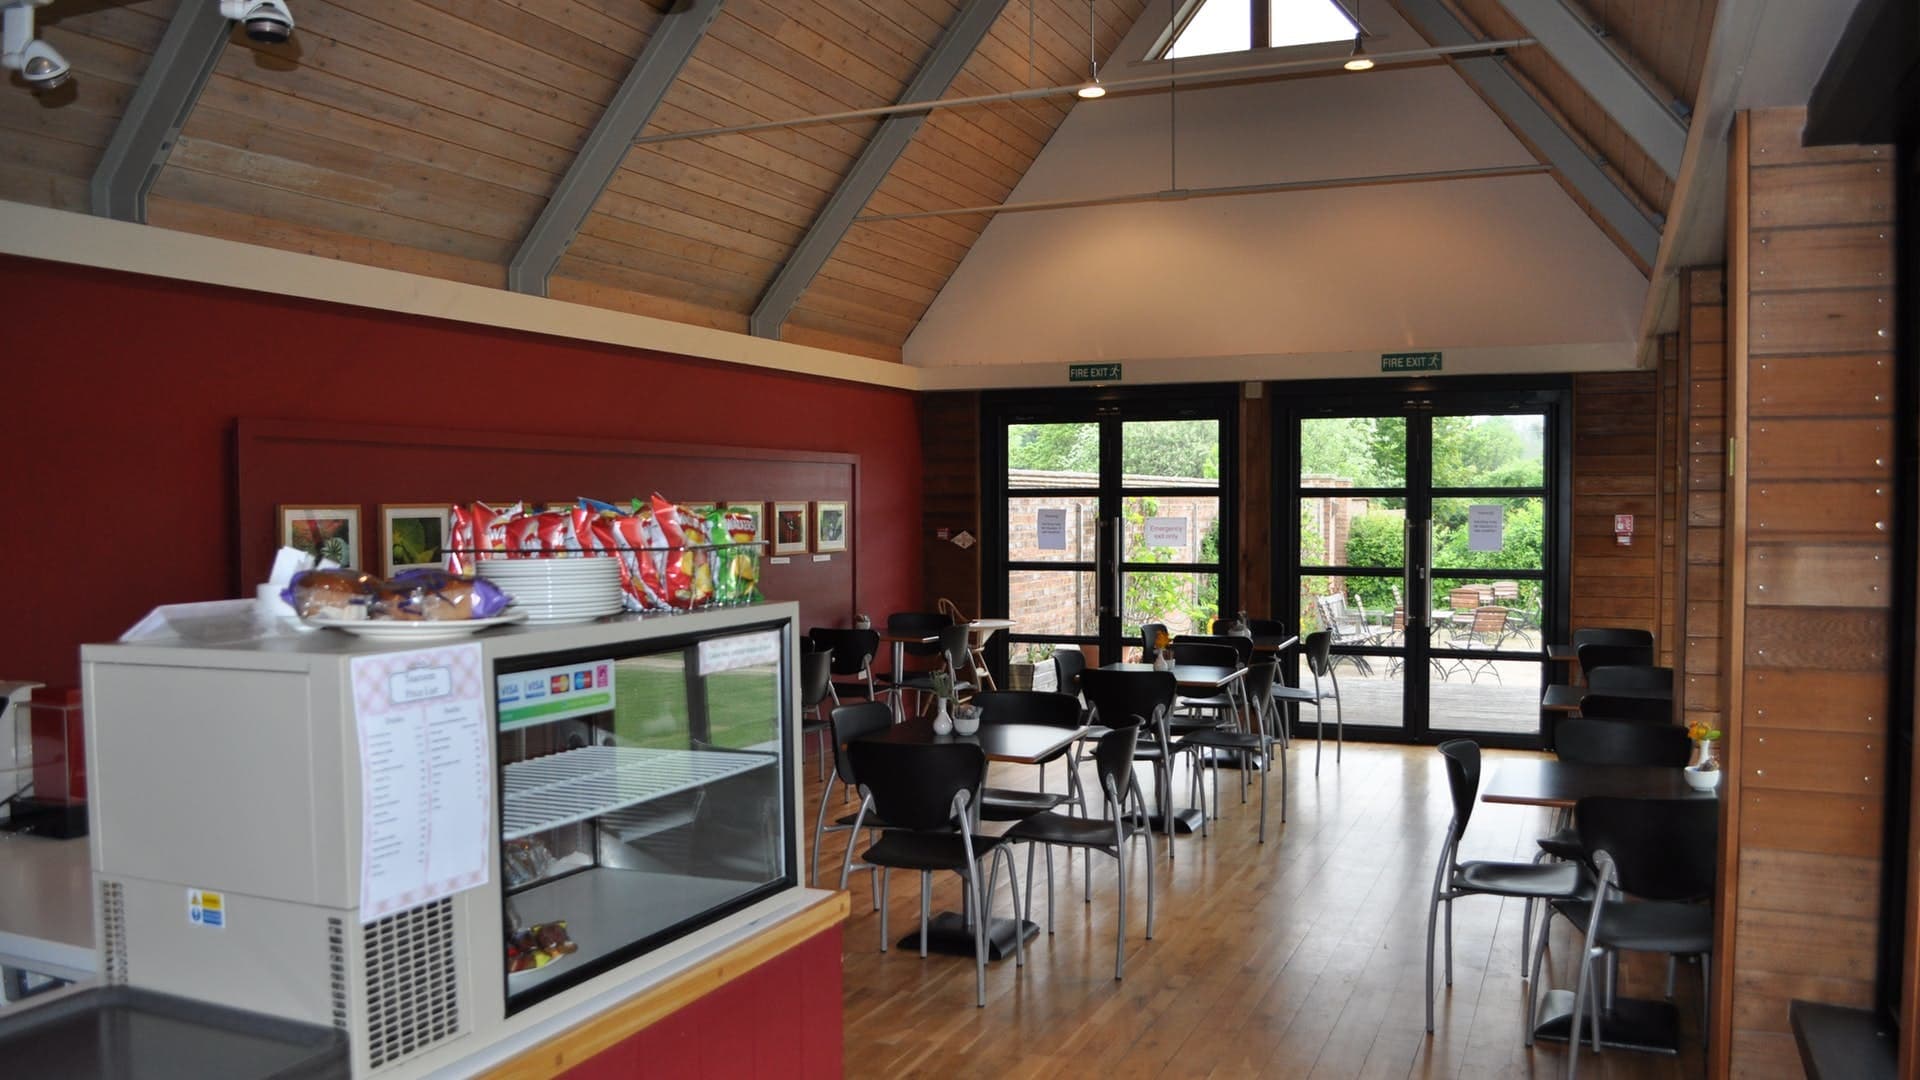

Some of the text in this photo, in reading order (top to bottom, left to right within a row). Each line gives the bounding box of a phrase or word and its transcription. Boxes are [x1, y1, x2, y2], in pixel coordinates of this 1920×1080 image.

[1383, 356, 1426, 369] FIRE EXIT
[1071, 367, 1108, 378] FIRE EXIT
[1150, 525, 1182, 534] Emergency
[501, 684, 518, 696] VISA
[528, 680, 545, 691] VISA
